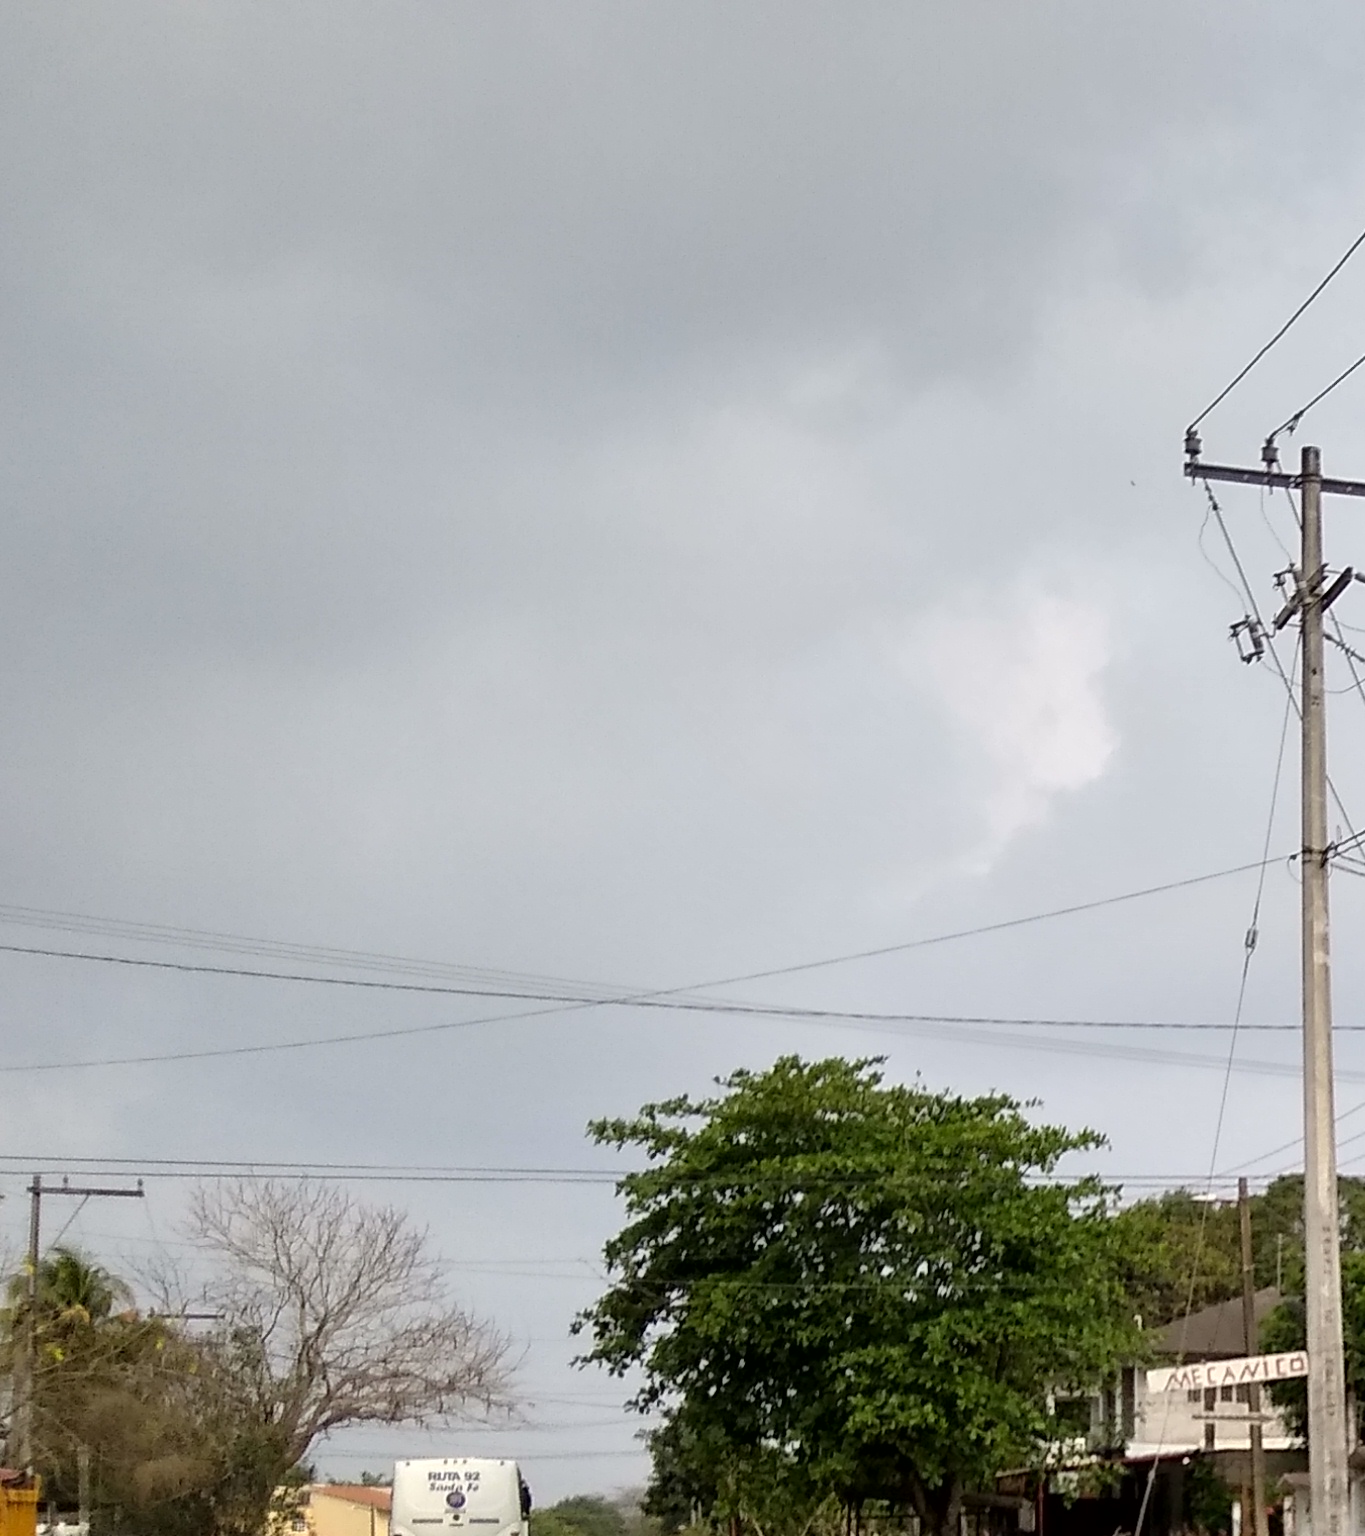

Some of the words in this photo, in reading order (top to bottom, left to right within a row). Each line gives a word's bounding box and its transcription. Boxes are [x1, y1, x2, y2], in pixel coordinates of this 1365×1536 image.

[1163, 1357, 1305, 1391] MECANICO
[428, 1472, 460, 1481] RUTA
[464, 1472, 481, 1481] 92
